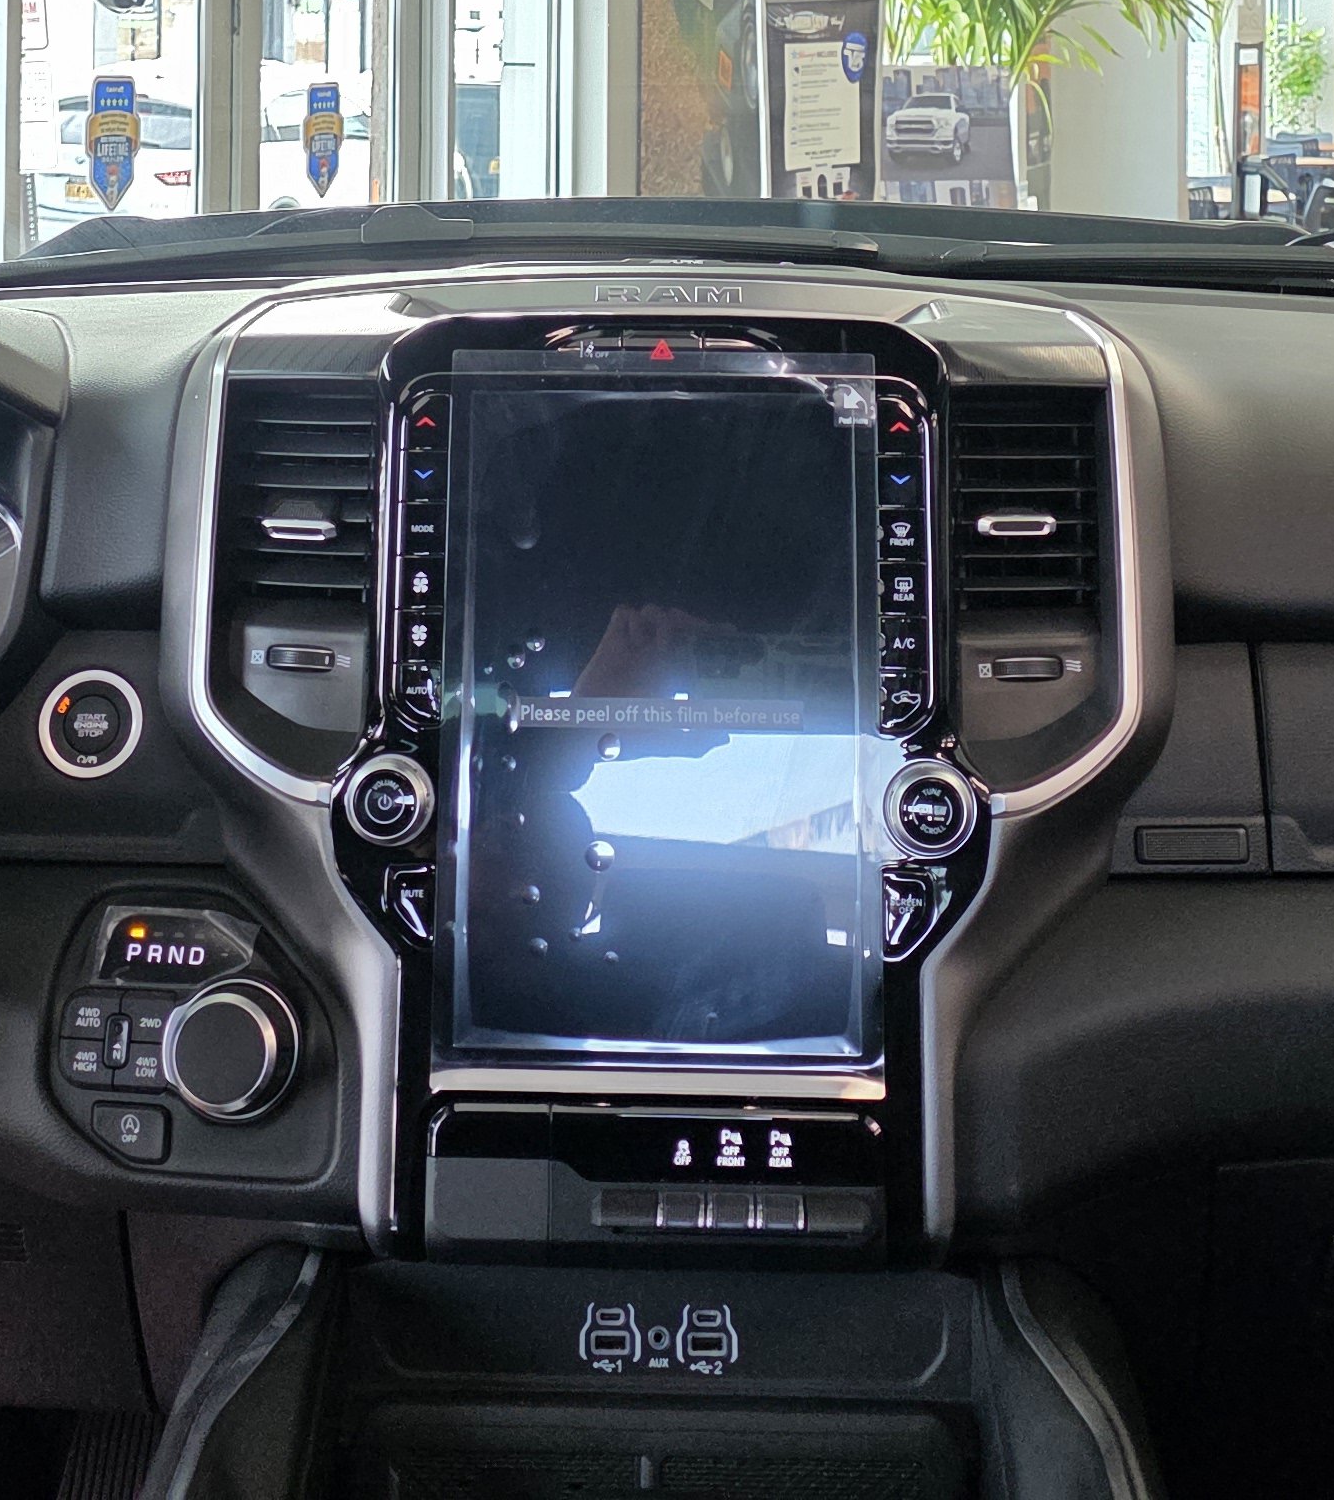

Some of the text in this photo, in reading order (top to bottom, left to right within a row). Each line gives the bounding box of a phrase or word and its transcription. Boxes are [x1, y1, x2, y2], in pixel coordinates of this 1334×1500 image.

[594, 285, 743, 303] RAM
[411, 524, 435, 533] MODE
[889, 538, 915, 547] FRONT
[893, 593, 915, 602] REAR
[893, 637, 916, 650] A/C
[406, 686, 428, 695] AUTO
[520, 703, 801, 725] Please peel off this film before use
[73, 720, 109, 731] ENGINE
[77, 729, 104, 738] STOP
[371, 779, 400, 791] VOLUME
[921, 787, 943, 797] TUNE
[919, 824, 947, 835] SCROLL
[400, 888, 424, 899] MUTE
[889, 898, 923, 908] SCREEN
[898, 906, 915, 916] OFF
[78, 1006, 100, 1018] 4WD
[75, 1017, 101, 1028] AUTO
[139, 1017, 162, 1029] 2WD
[75, 1051, 97, 1063] 4WD
[135, 1056, 158, 1068] 4WD
[72, 1061, 97, 1072] HIGH
[135, 1067, 157, 1078] LOW
[121, 1134, 138, 1144] OFF
[722, 1145, 740, 1156] OFF
[771, 1147, 790, 1157] OFF
[673, 1155, 692, 1166] OFF
[716, 1156, 746, 1167] FRONT
[768, 1157, 793, 1168] REAR
[648, 1357, 669, 1369] AUX
